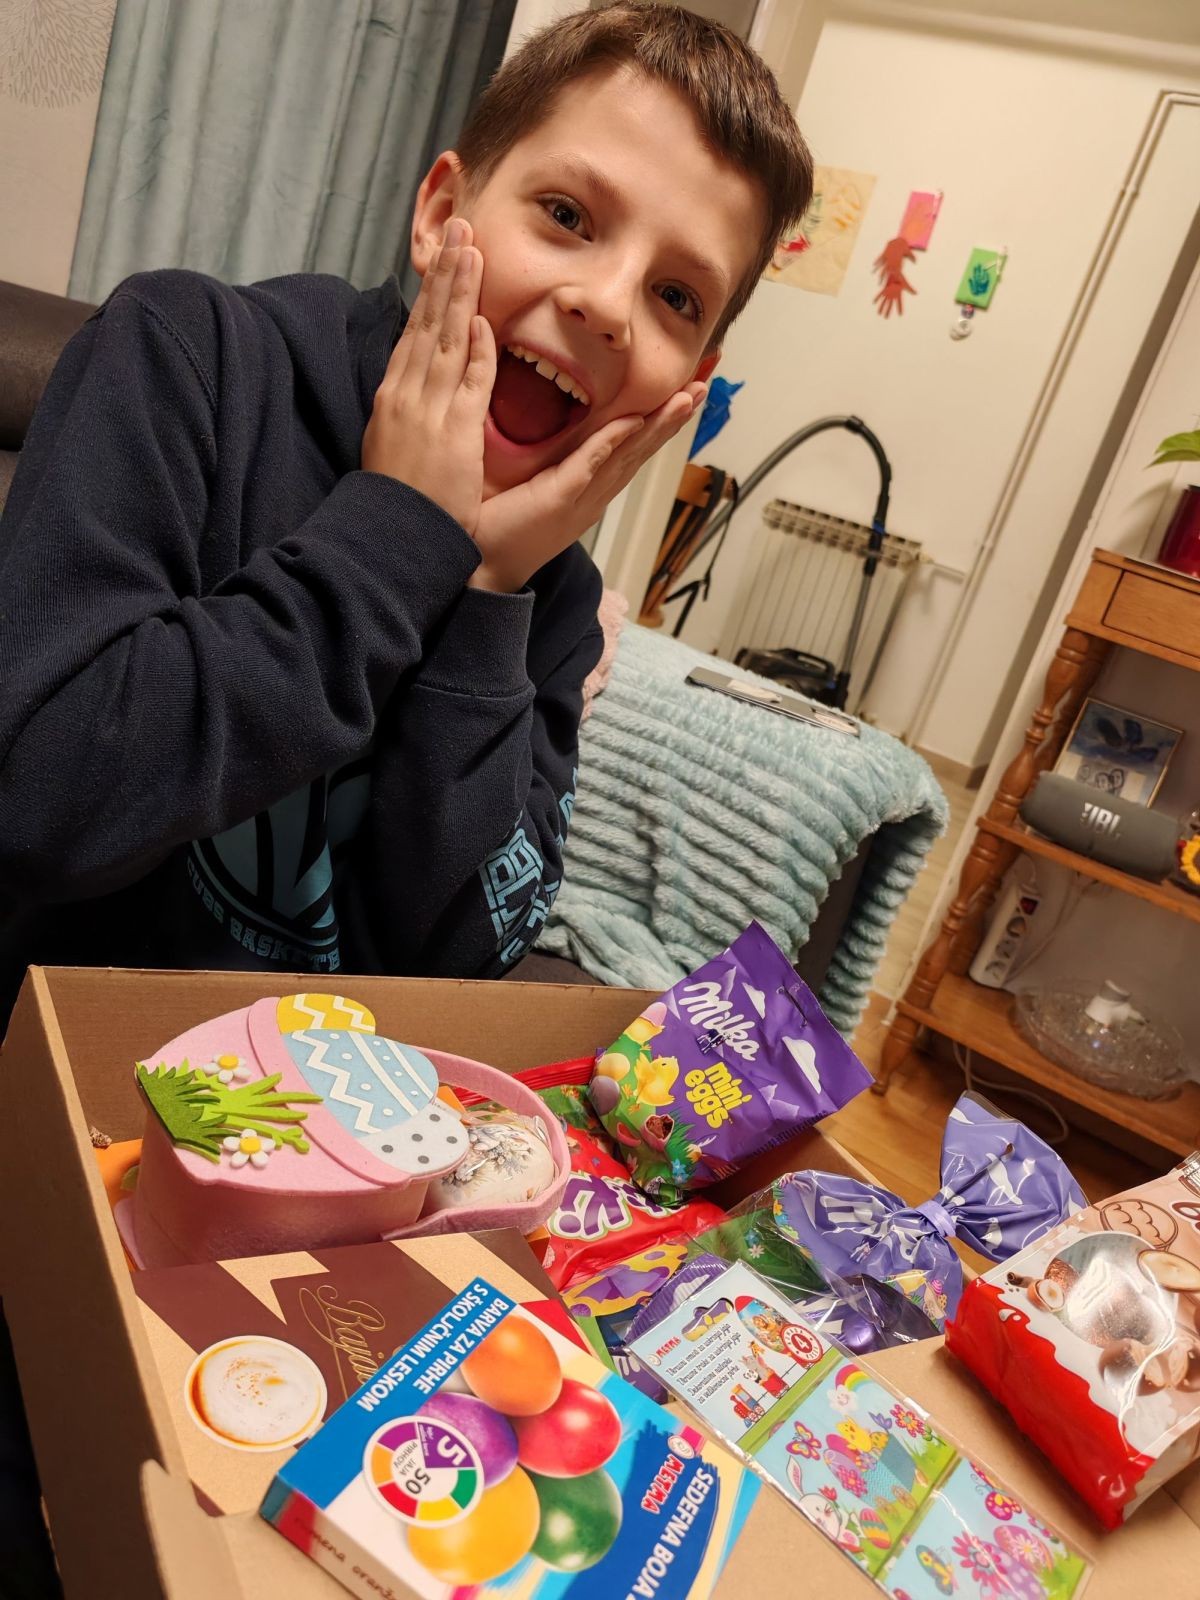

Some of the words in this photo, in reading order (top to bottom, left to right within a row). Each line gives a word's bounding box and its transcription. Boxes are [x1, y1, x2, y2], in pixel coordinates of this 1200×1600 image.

[678, 981, 760, 1061] Milka
[684, 1069, 730, 1129] eggs
[704, 1061, 753, 1111] mini
[473, 1283, 489, 1297] S
[466, 1298, 509, 1337] BARVA
[449, 1333, 475, 1355] ZA
[794, 1335, 810, 1350] 4
[356, 1354, 419, 1412] LESKOM
[412, 1351, 458, 1394] PIRHE
[437, 1435, 467, 1466] 5
[405, 1468, 431, 1494] 50
[641, 1453, 685, 1515] METMA
[660, 1467, 715, 1547] SEDEFNA
[632, 1542, 675, 1599] BOJA
